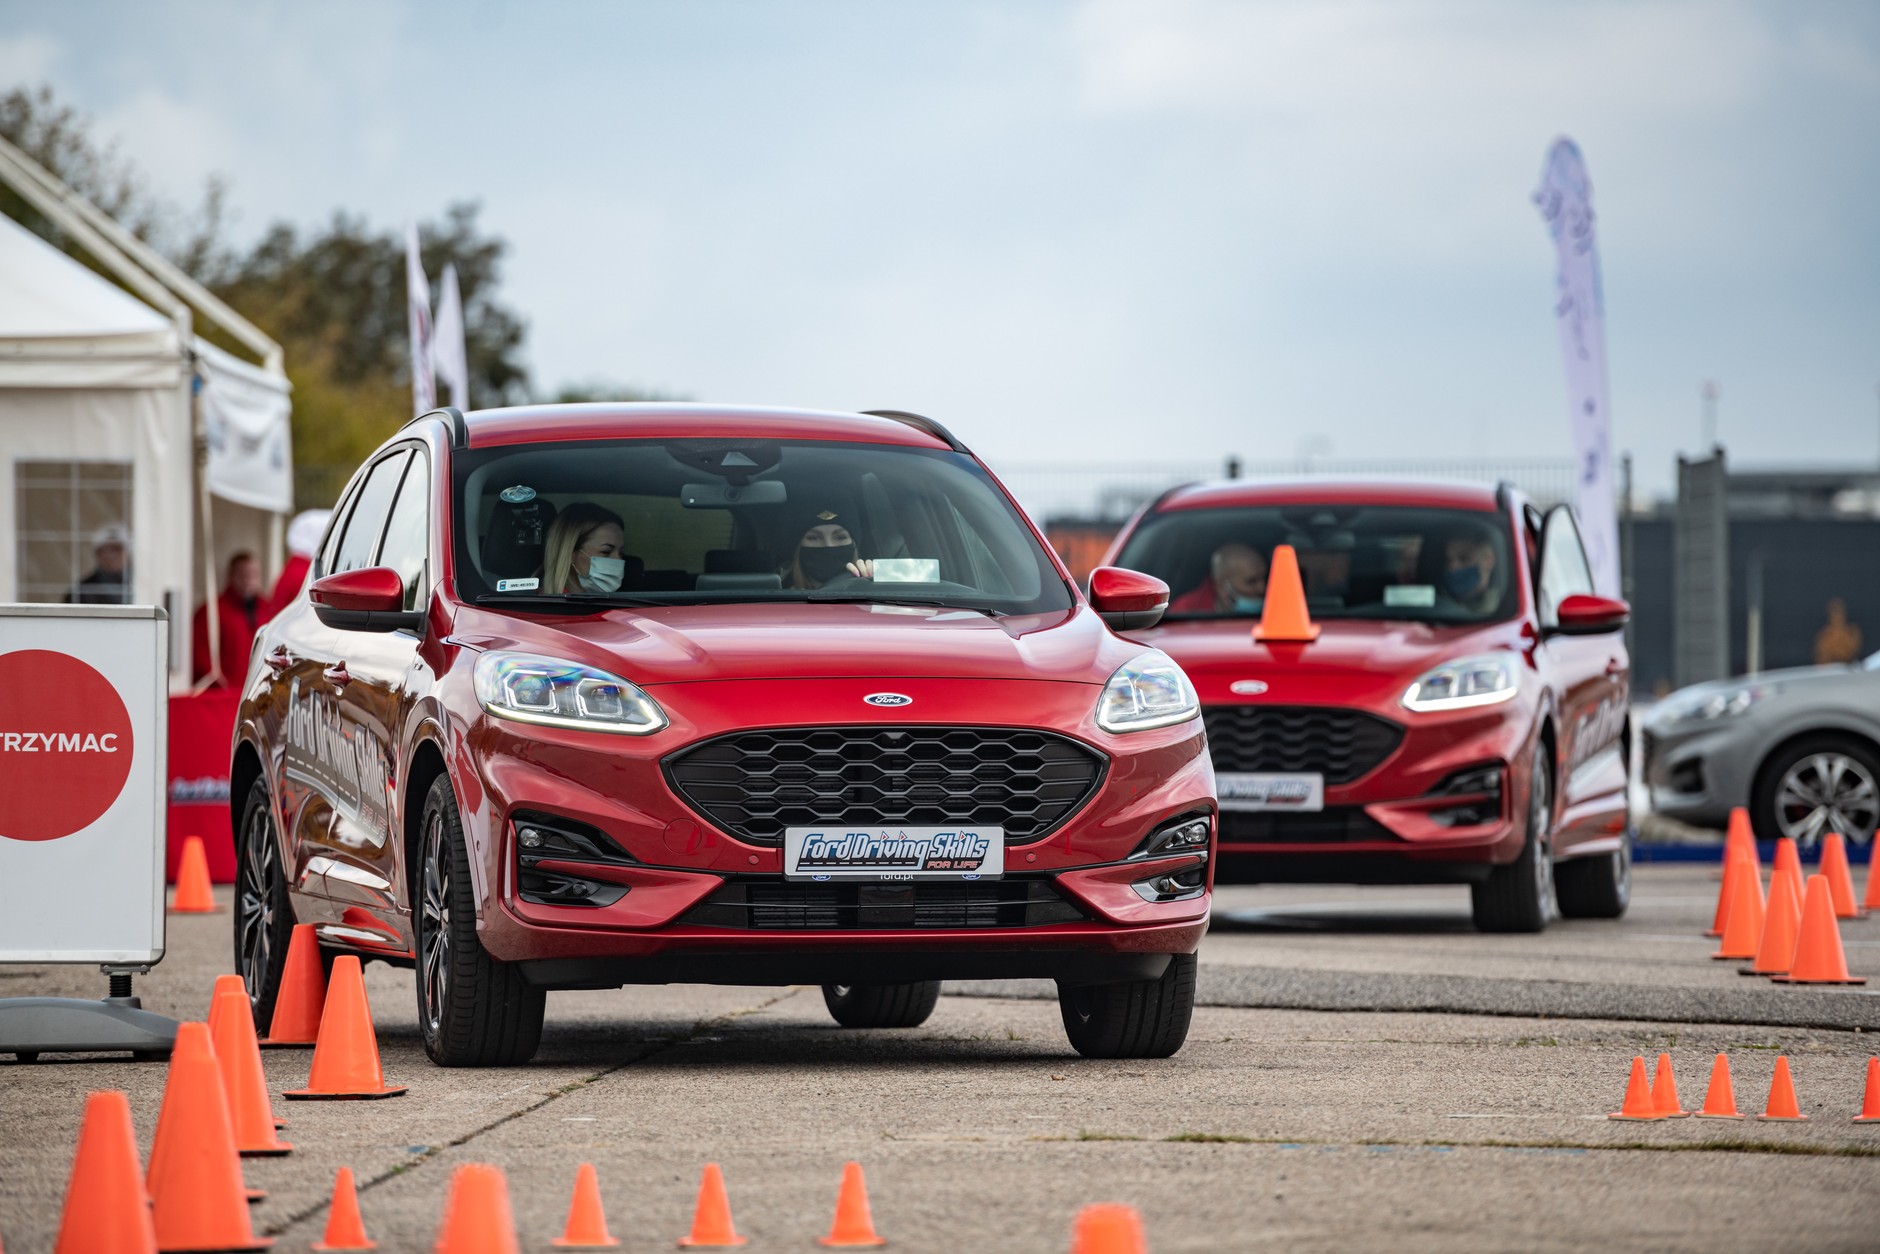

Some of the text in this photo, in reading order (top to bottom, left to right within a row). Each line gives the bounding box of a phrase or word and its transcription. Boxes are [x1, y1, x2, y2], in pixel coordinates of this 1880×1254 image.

[875, 695, 902, 704] Ford
[0, 732, 118, 753] RZYMAC
[926, 860, 951, 869] FOR
